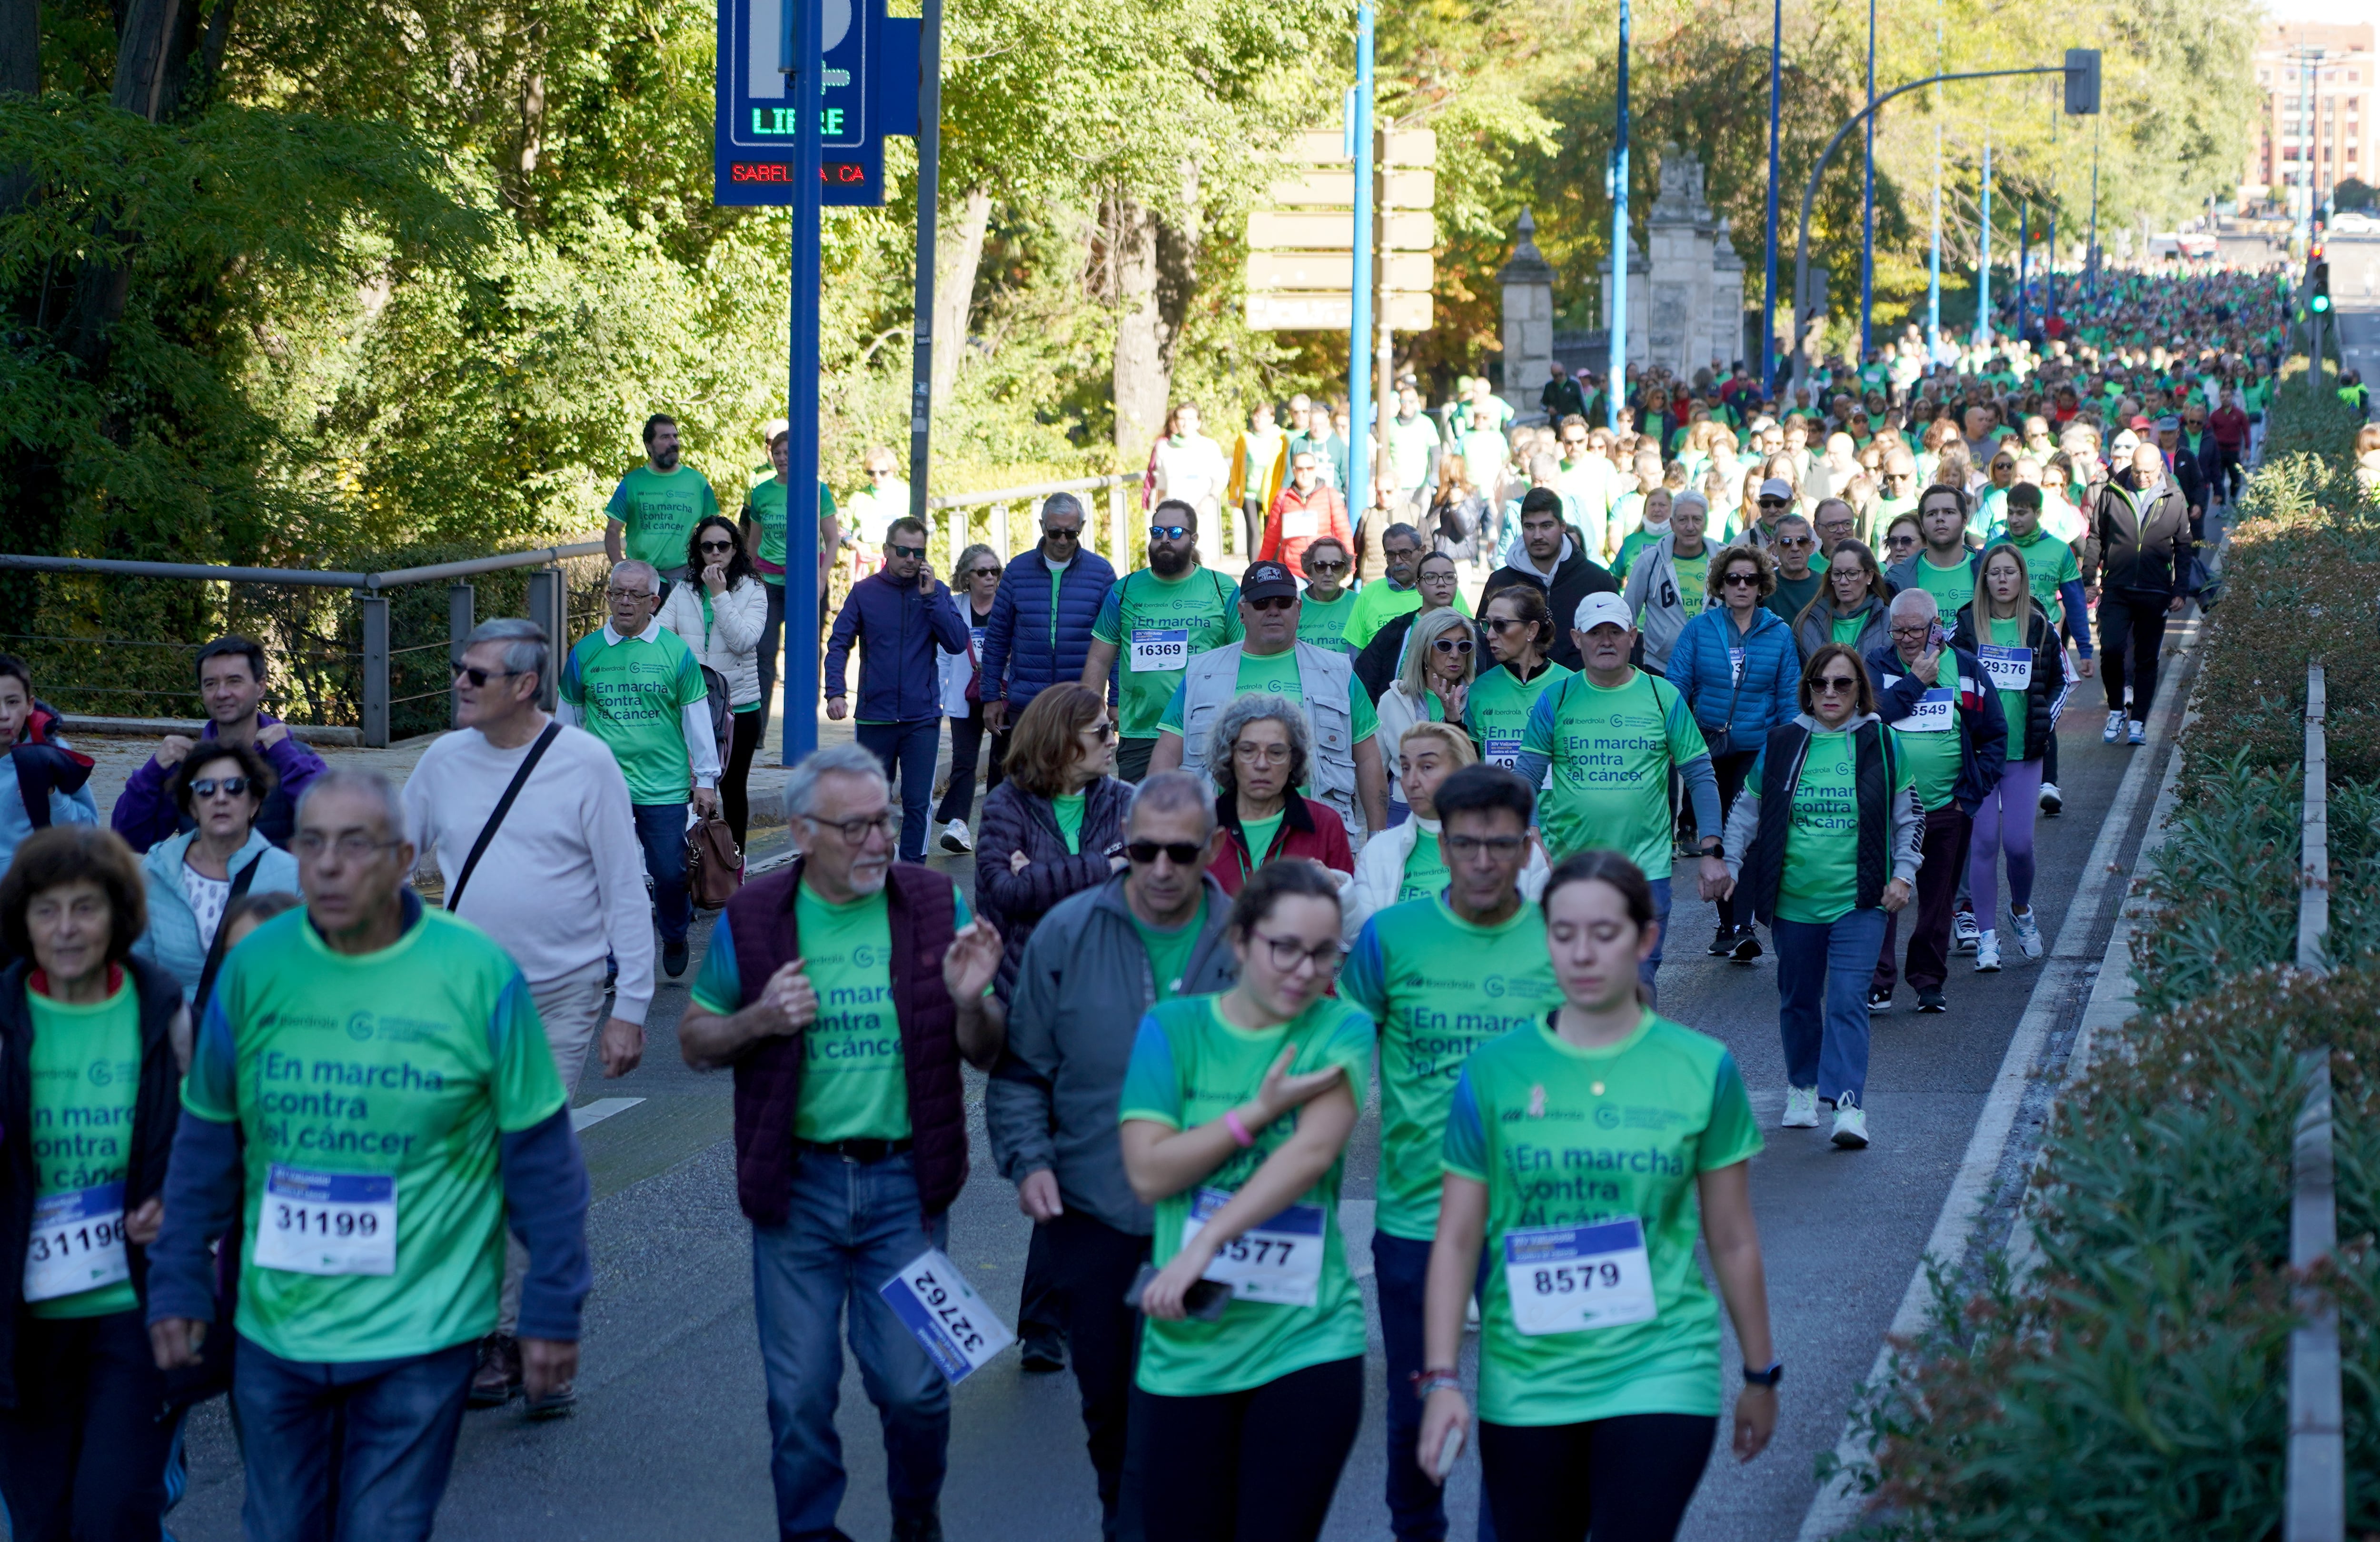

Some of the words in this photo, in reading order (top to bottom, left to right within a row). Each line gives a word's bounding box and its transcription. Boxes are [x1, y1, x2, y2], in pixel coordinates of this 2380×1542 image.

[643, 503, 655, 511] En
[657, 503, 693, 514] marcha
[654, 522, 684, 531] cáncer
[1138, 616, 1154, 626] En
[1159, 616, 1210, 628] marcha
[1137, 644, 1181, 656] 16369
[1983, 661, 2026, 675] 29376
[597, 682, 614, 694] En
[618, 681, 668, 694] marcha
[598, 695, 642, 707] contra
[602, 709, 613, 720] el
[614, 708, 660, 720] cáncer
[1488, 726, 1507, 738] En
[1570, 736, 1589, 749] En
[1595, 736, 1656, 750] marcha
[1572, 753, 1623, 766] contra
[1572, 768, 1584, 781] el
[1589, 768, 1642, 781] cáncer
[1795, 784, 1815, 797] En
[1793, 800, 1851, 812] contra
[1796, 815, 1811, 827] el
[1413, 867, 1449, 877] Iberdrola
[1415, 1007, 1447, 1029] En
[267, 1051, 302, 1082] En
[312, 1060, 444, 1091] marcha
[263, 1090, 369, 1120] contra
[298, 1123, 418, 1155] cáncer
[1517, 1143, 1551, 1172] En
[1563, 1145, 1684, 1176] marcha
[276, 1204, 378, 1237] 31199
[1535, 1262, 1621, 1295] 8579
[915, 1270, 984, 1353] 32762
